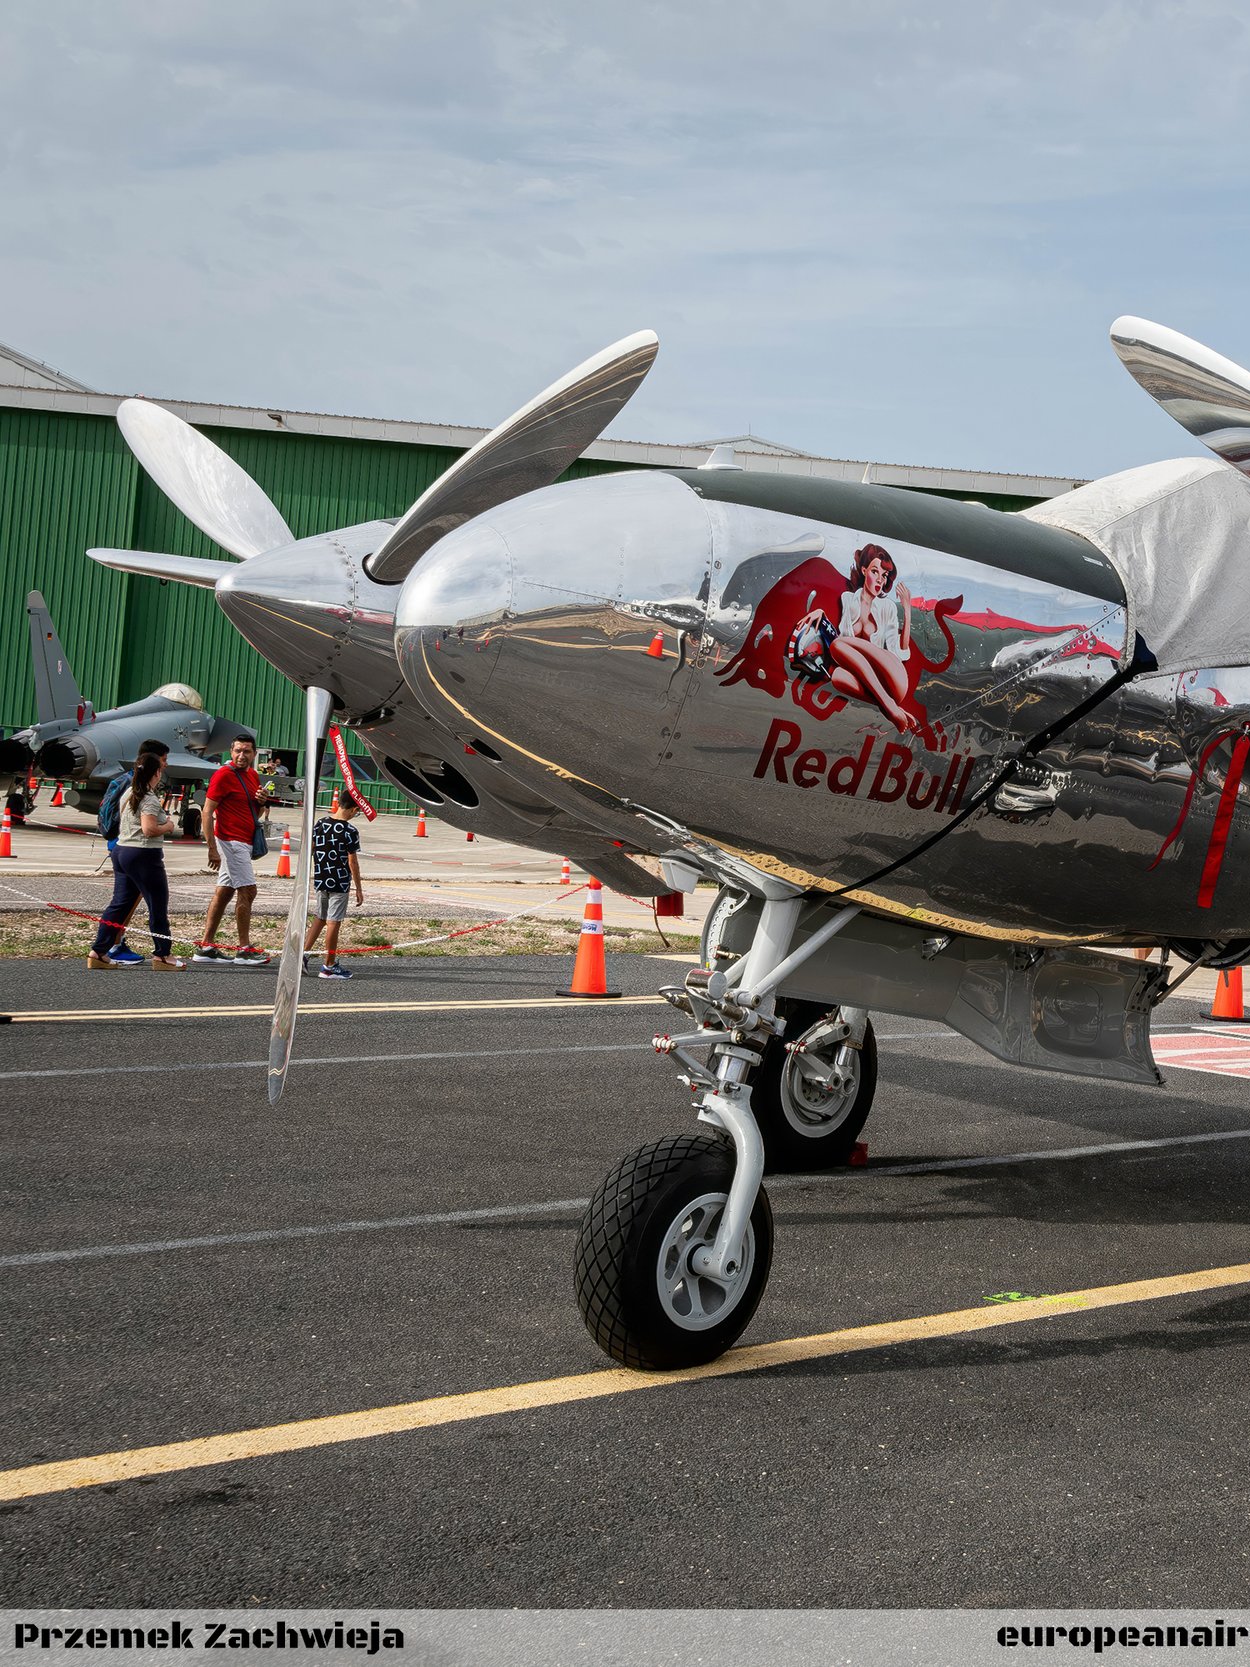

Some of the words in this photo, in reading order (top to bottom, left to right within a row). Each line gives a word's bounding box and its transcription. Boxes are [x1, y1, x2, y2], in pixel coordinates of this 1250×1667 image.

[334, 734, 347, 763] REMOVE
[340, 762, 355, 791] BEFORE
[753, 718, 876, 797] Red
[867, 741, 976, 816] Bull
